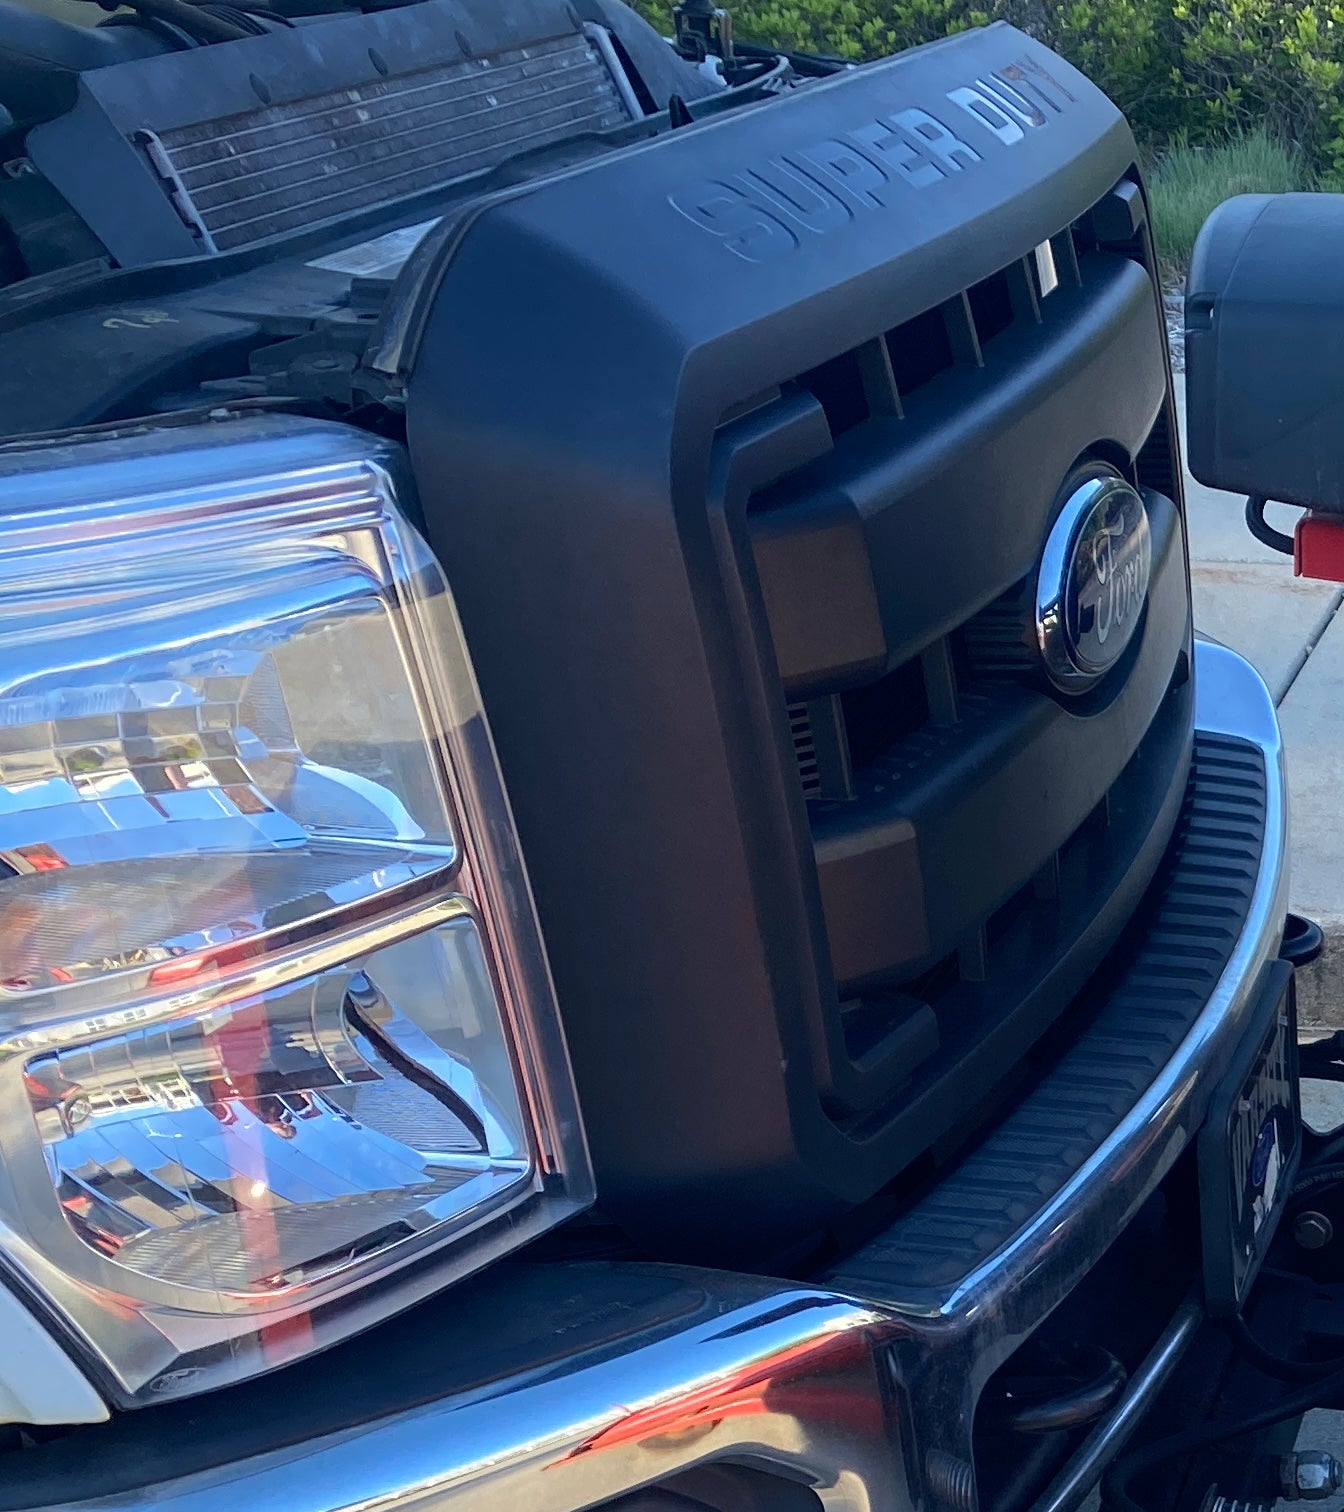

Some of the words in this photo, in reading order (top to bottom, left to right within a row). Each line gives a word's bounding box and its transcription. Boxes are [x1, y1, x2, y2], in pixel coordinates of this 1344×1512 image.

[667, 107, 985, 263] SUPER
[946, 53, 1077, 146] DUTY
[1093, 513, 1143, 643] Ford
